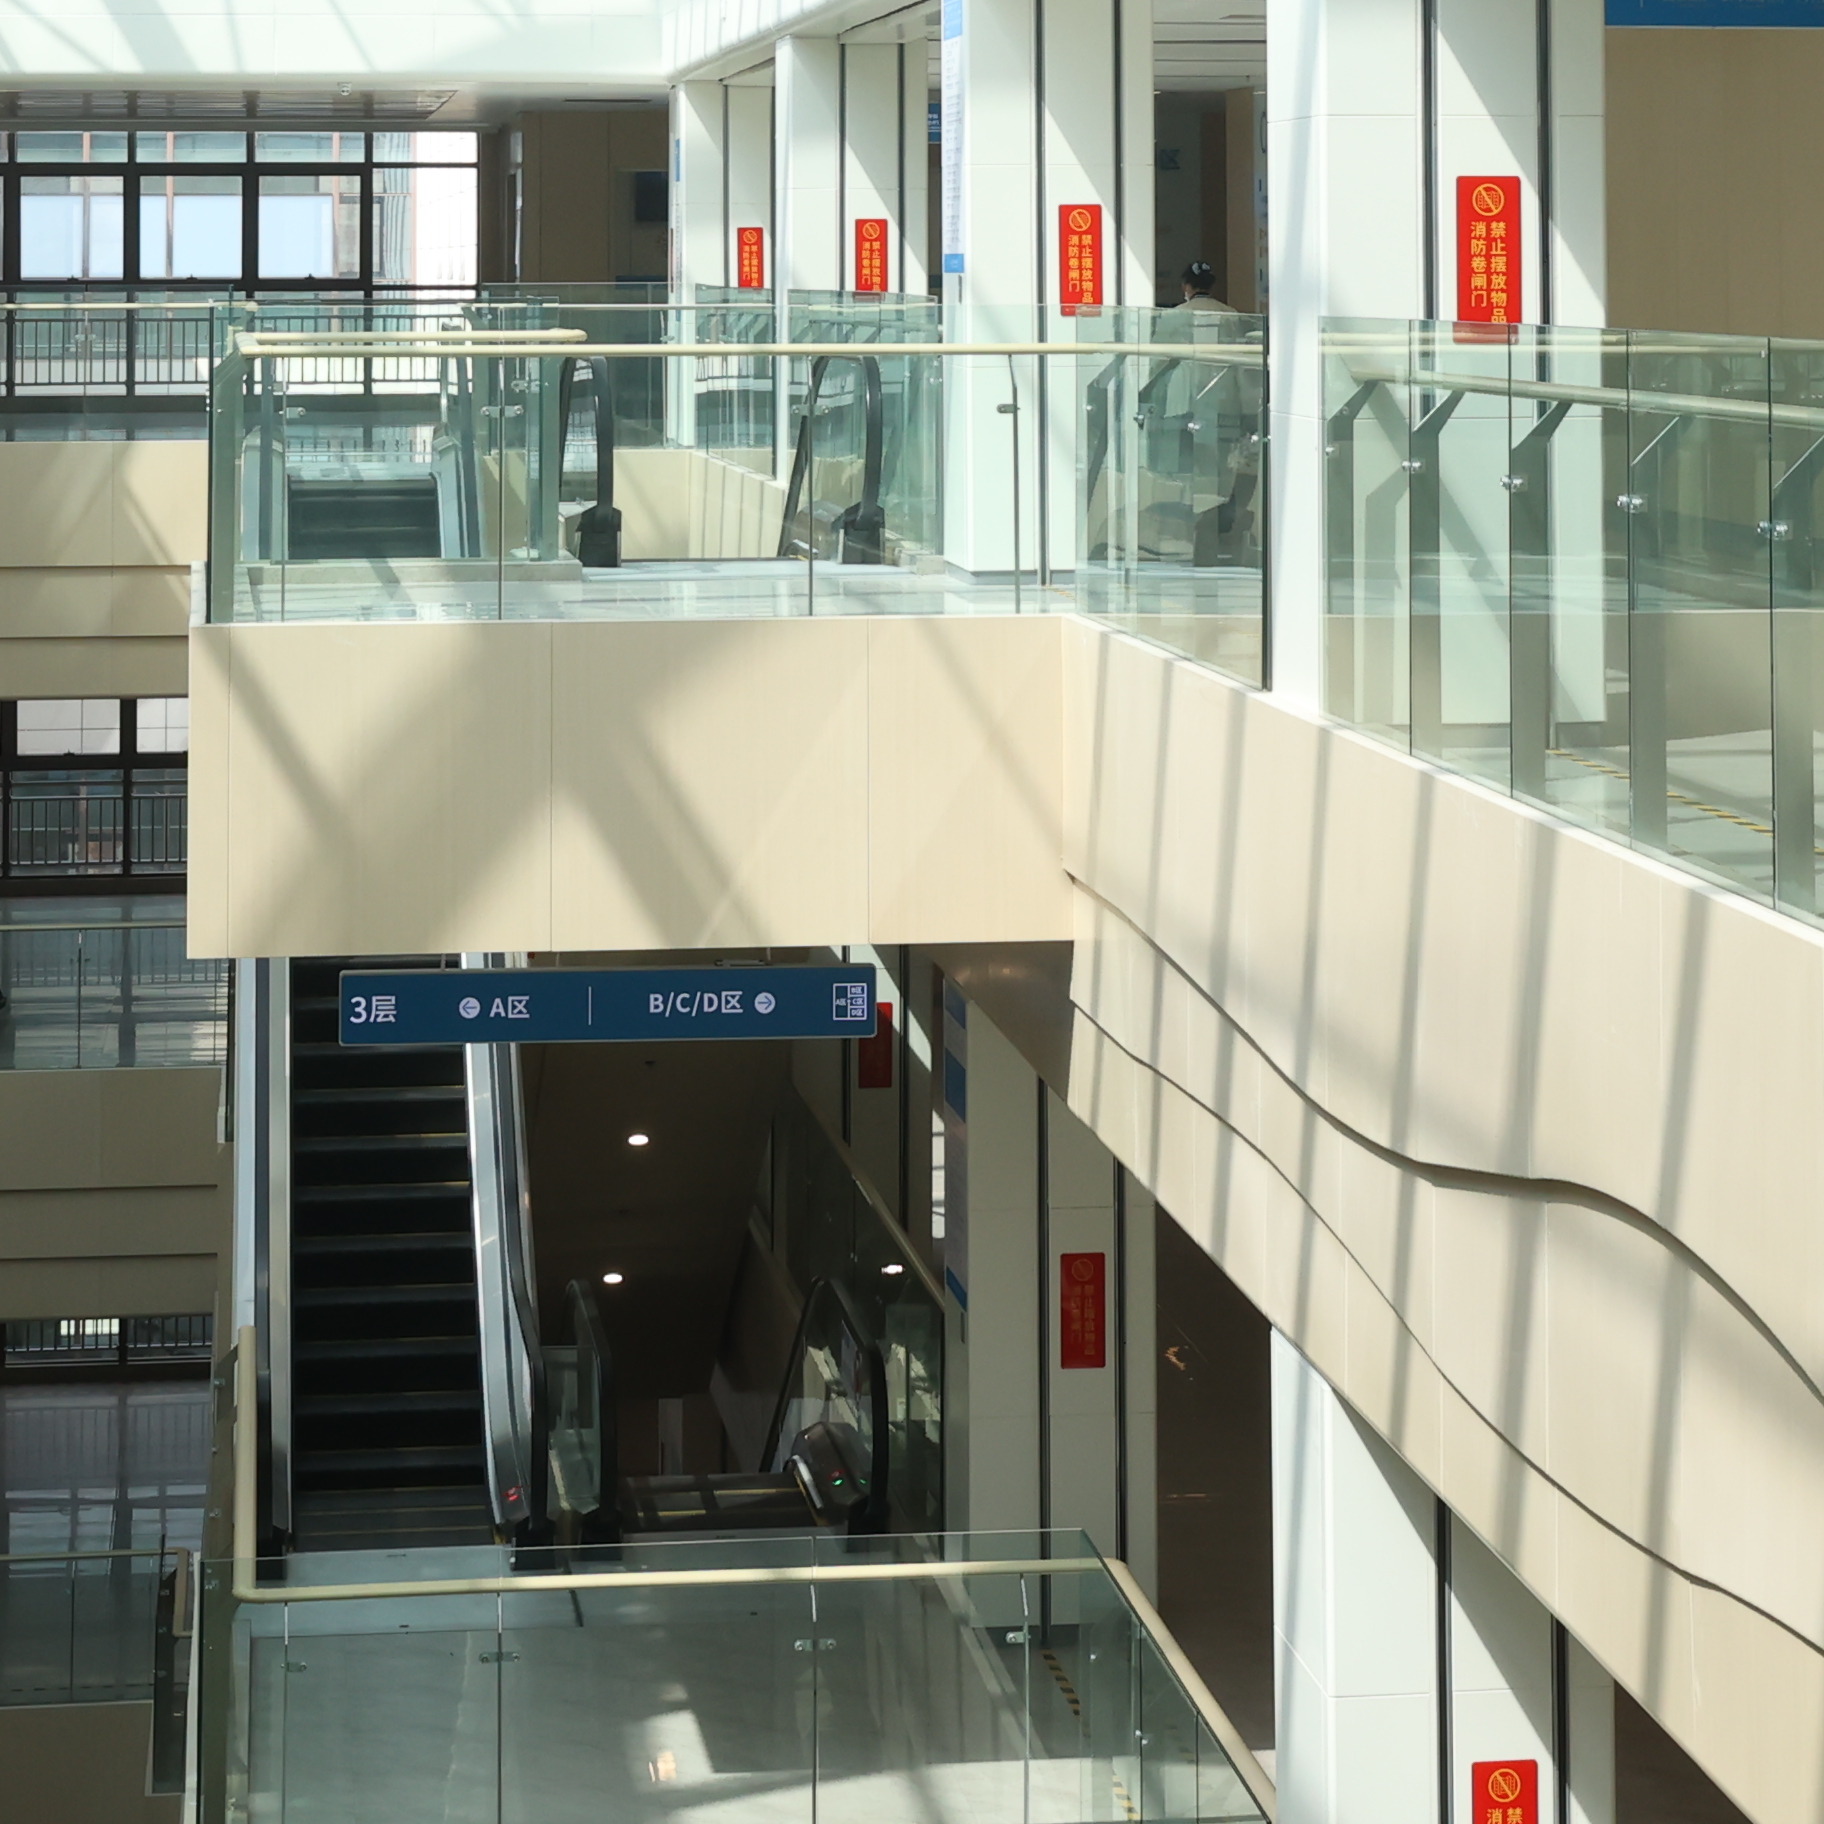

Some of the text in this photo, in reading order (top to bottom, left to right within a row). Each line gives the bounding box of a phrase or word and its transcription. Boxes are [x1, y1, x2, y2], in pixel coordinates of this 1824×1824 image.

[1470, 221, 1488, 308] 消防卷闸门
[1490, 221, 1508, 323] 禁止摆放物品
[349, 990, 744, 1024] 3层 A区 B/C/D区
